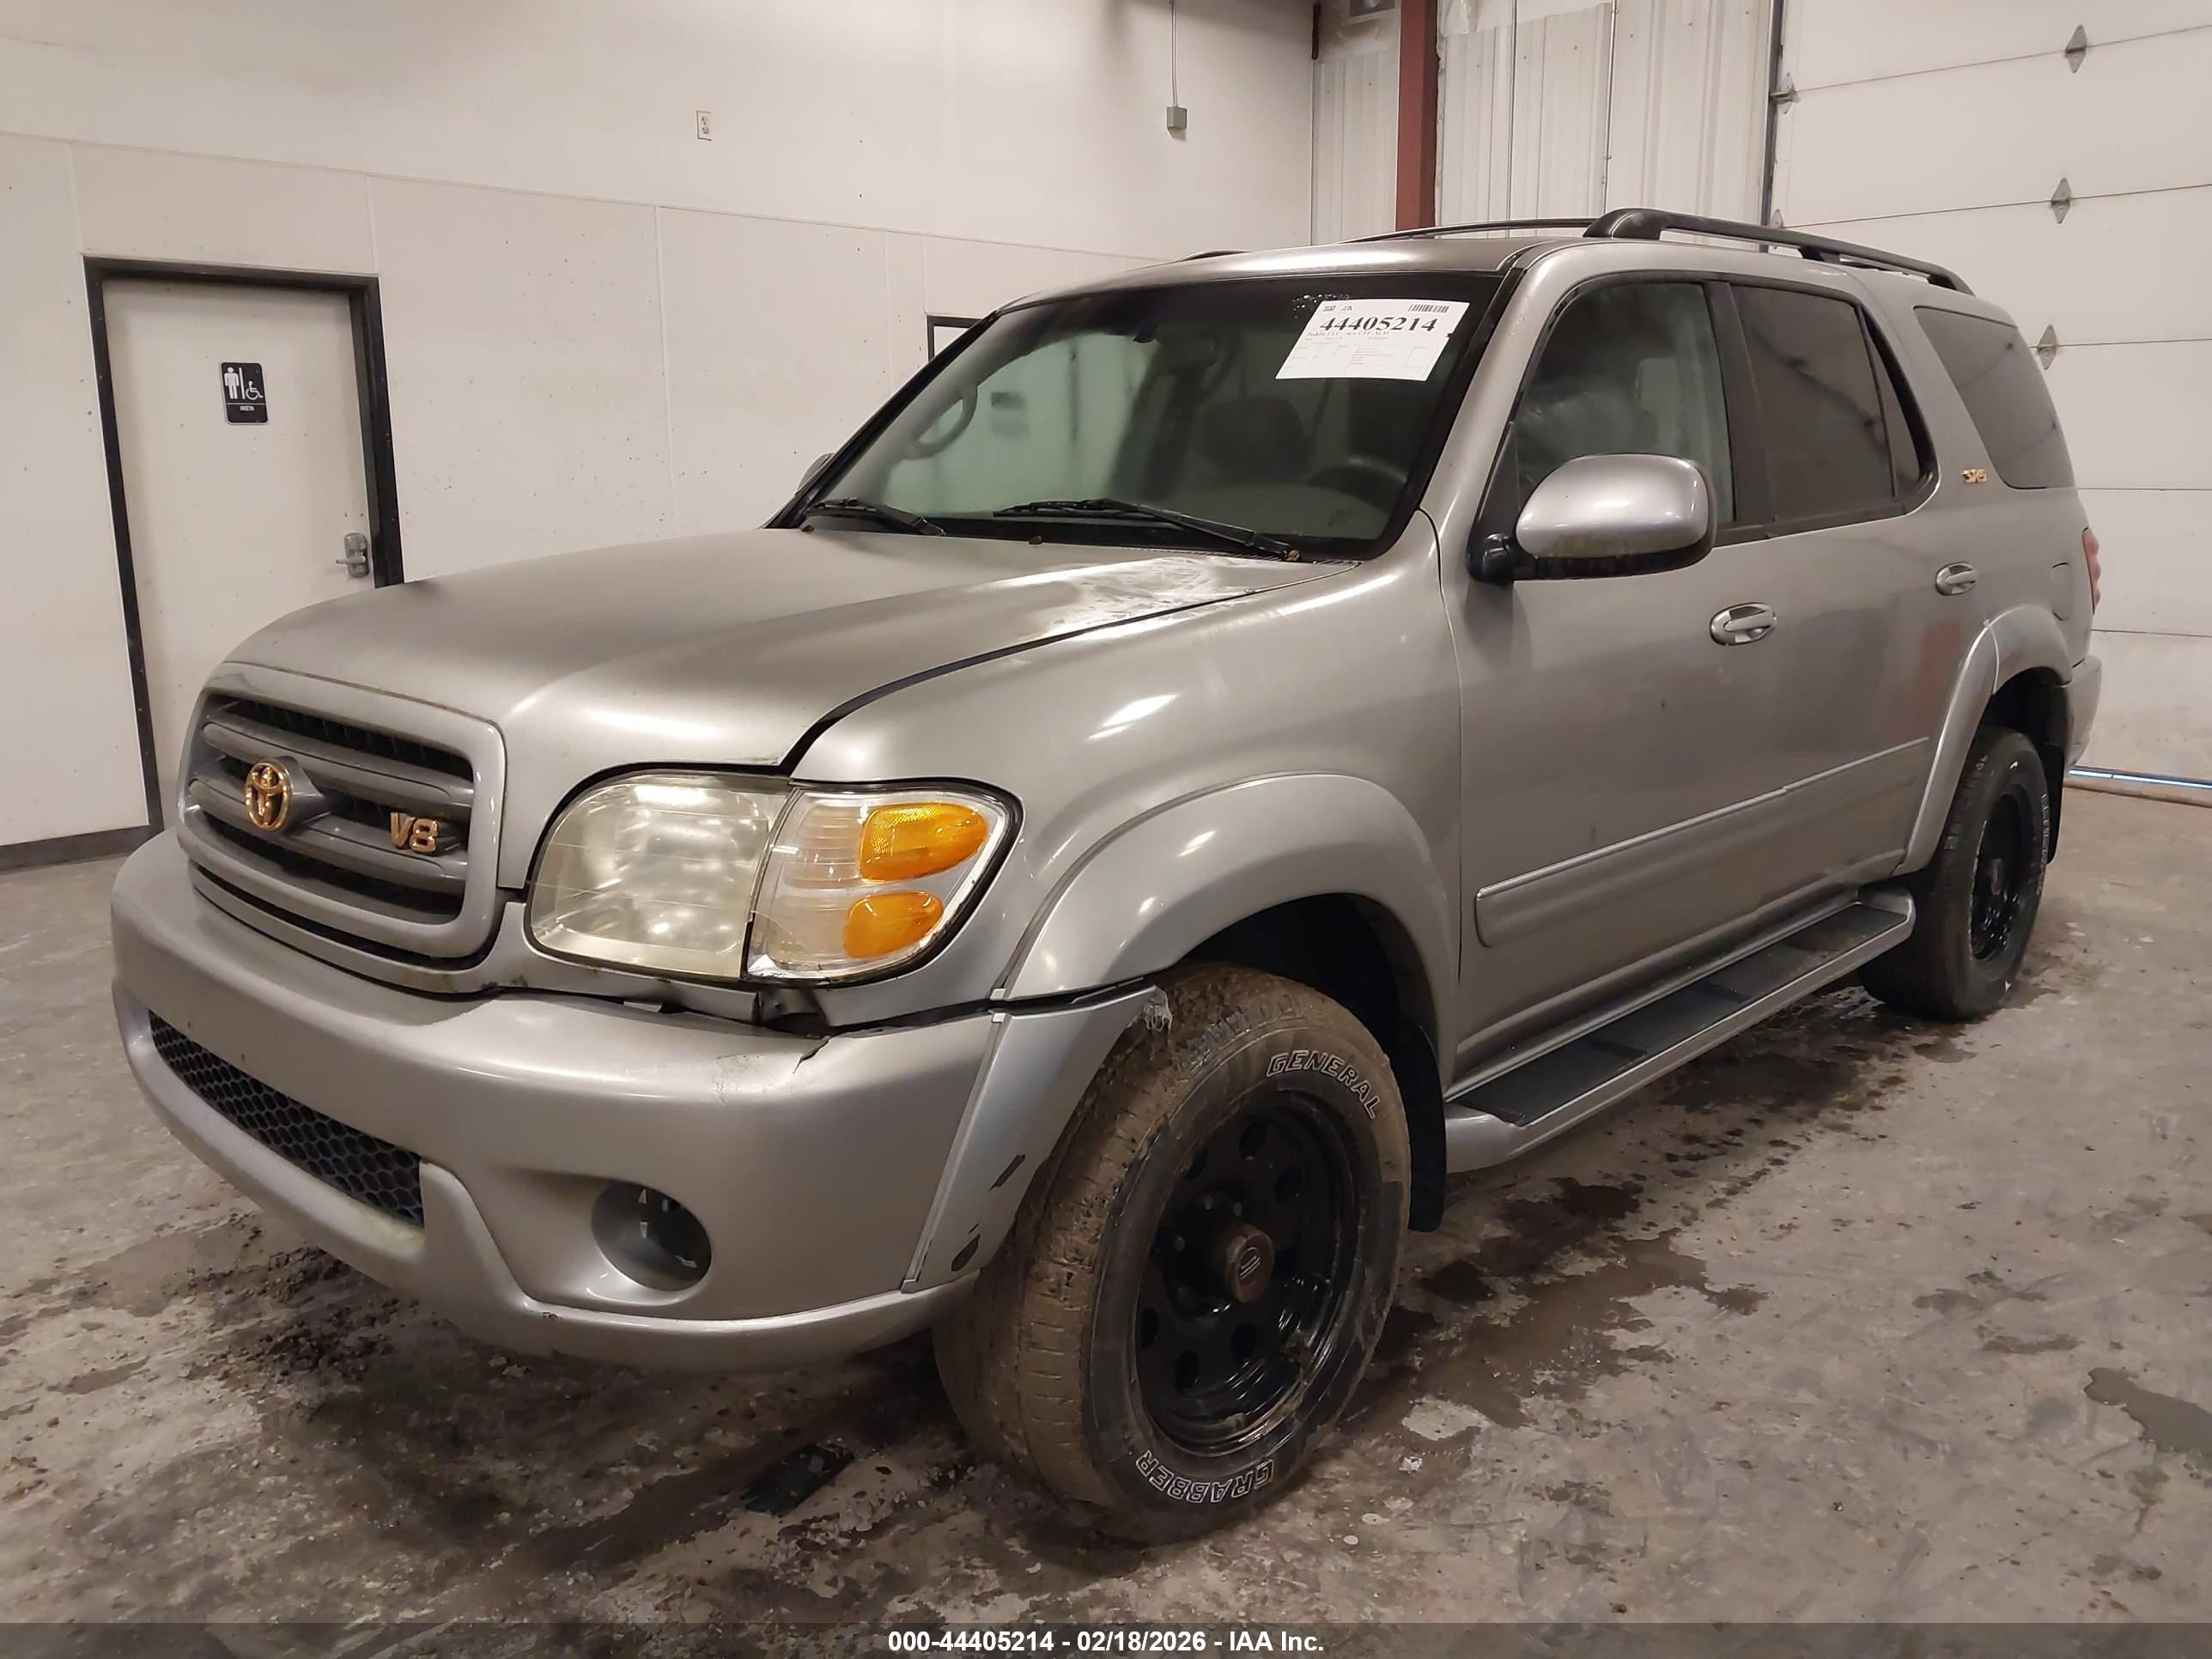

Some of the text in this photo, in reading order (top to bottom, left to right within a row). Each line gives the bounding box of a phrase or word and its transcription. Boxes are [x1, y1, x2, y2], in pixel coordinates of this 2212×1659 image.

[1320, 315, 1438, 332] 44405214
[390, 811, 439, 853] V8
[1266, 1049, 1381, 1120] GENERAL
[1135, 1449, 1274, 1504] GRABBER
